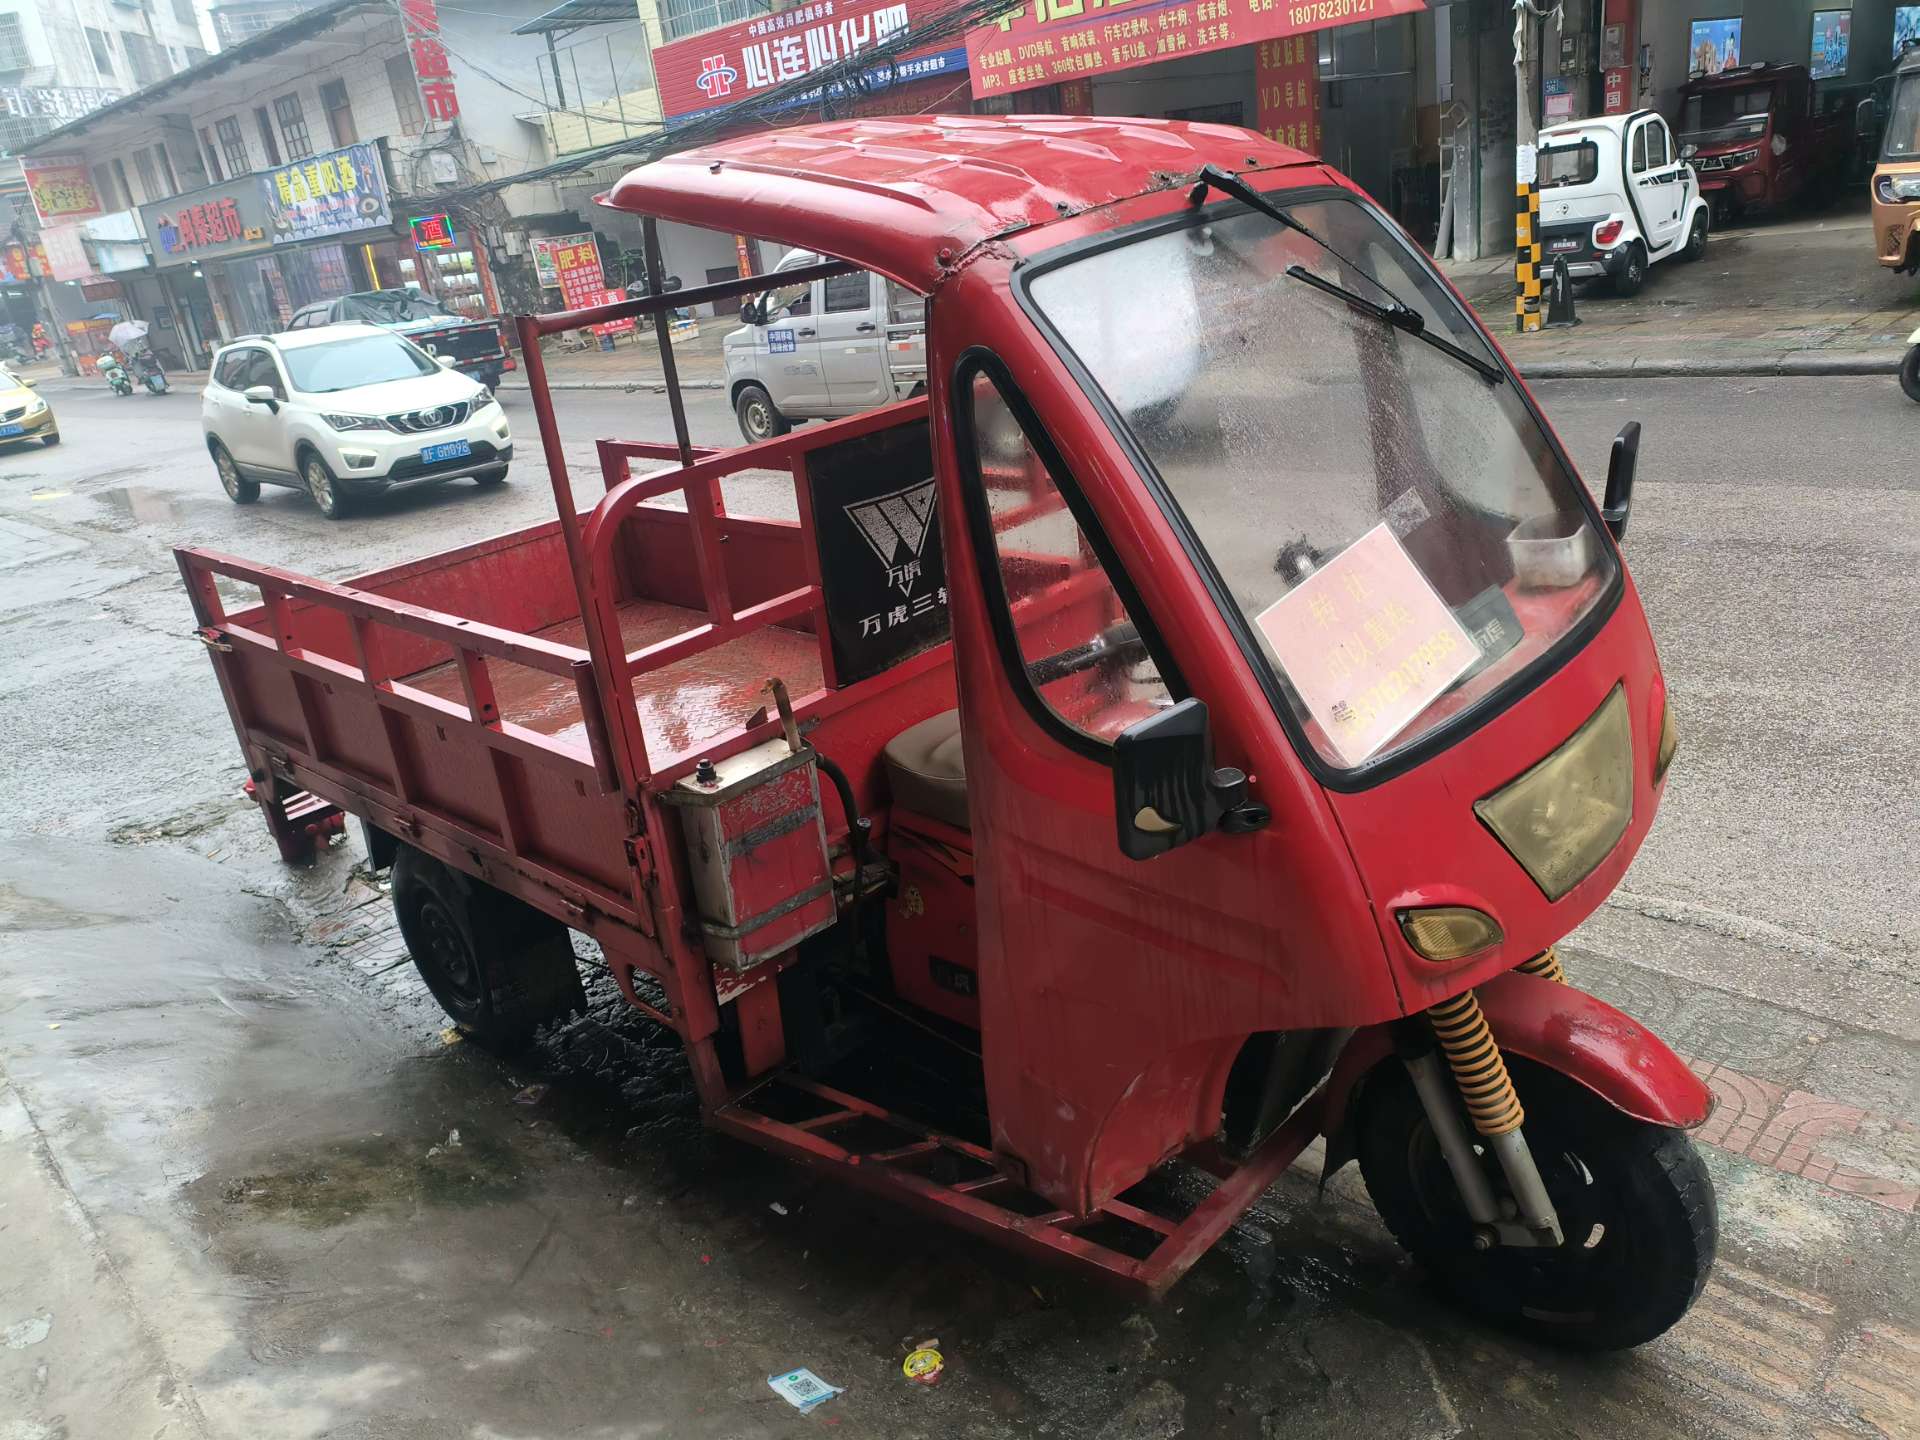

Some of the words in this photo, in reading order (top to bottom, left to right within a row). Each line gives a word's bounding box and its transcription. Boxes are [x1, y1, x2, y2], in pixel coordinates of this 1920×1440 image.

[748, 1, 834, 37] 中国高效用肥倡导者
[1288, 0, 1374, 27] 18078230121
[742, 3, 910, 90] 心连心化肥
[1260, 37, 1306, 69] 专业贴膜
[422, 220, 445, 240] 酒
[558, 244, 596, 270] 肥料
